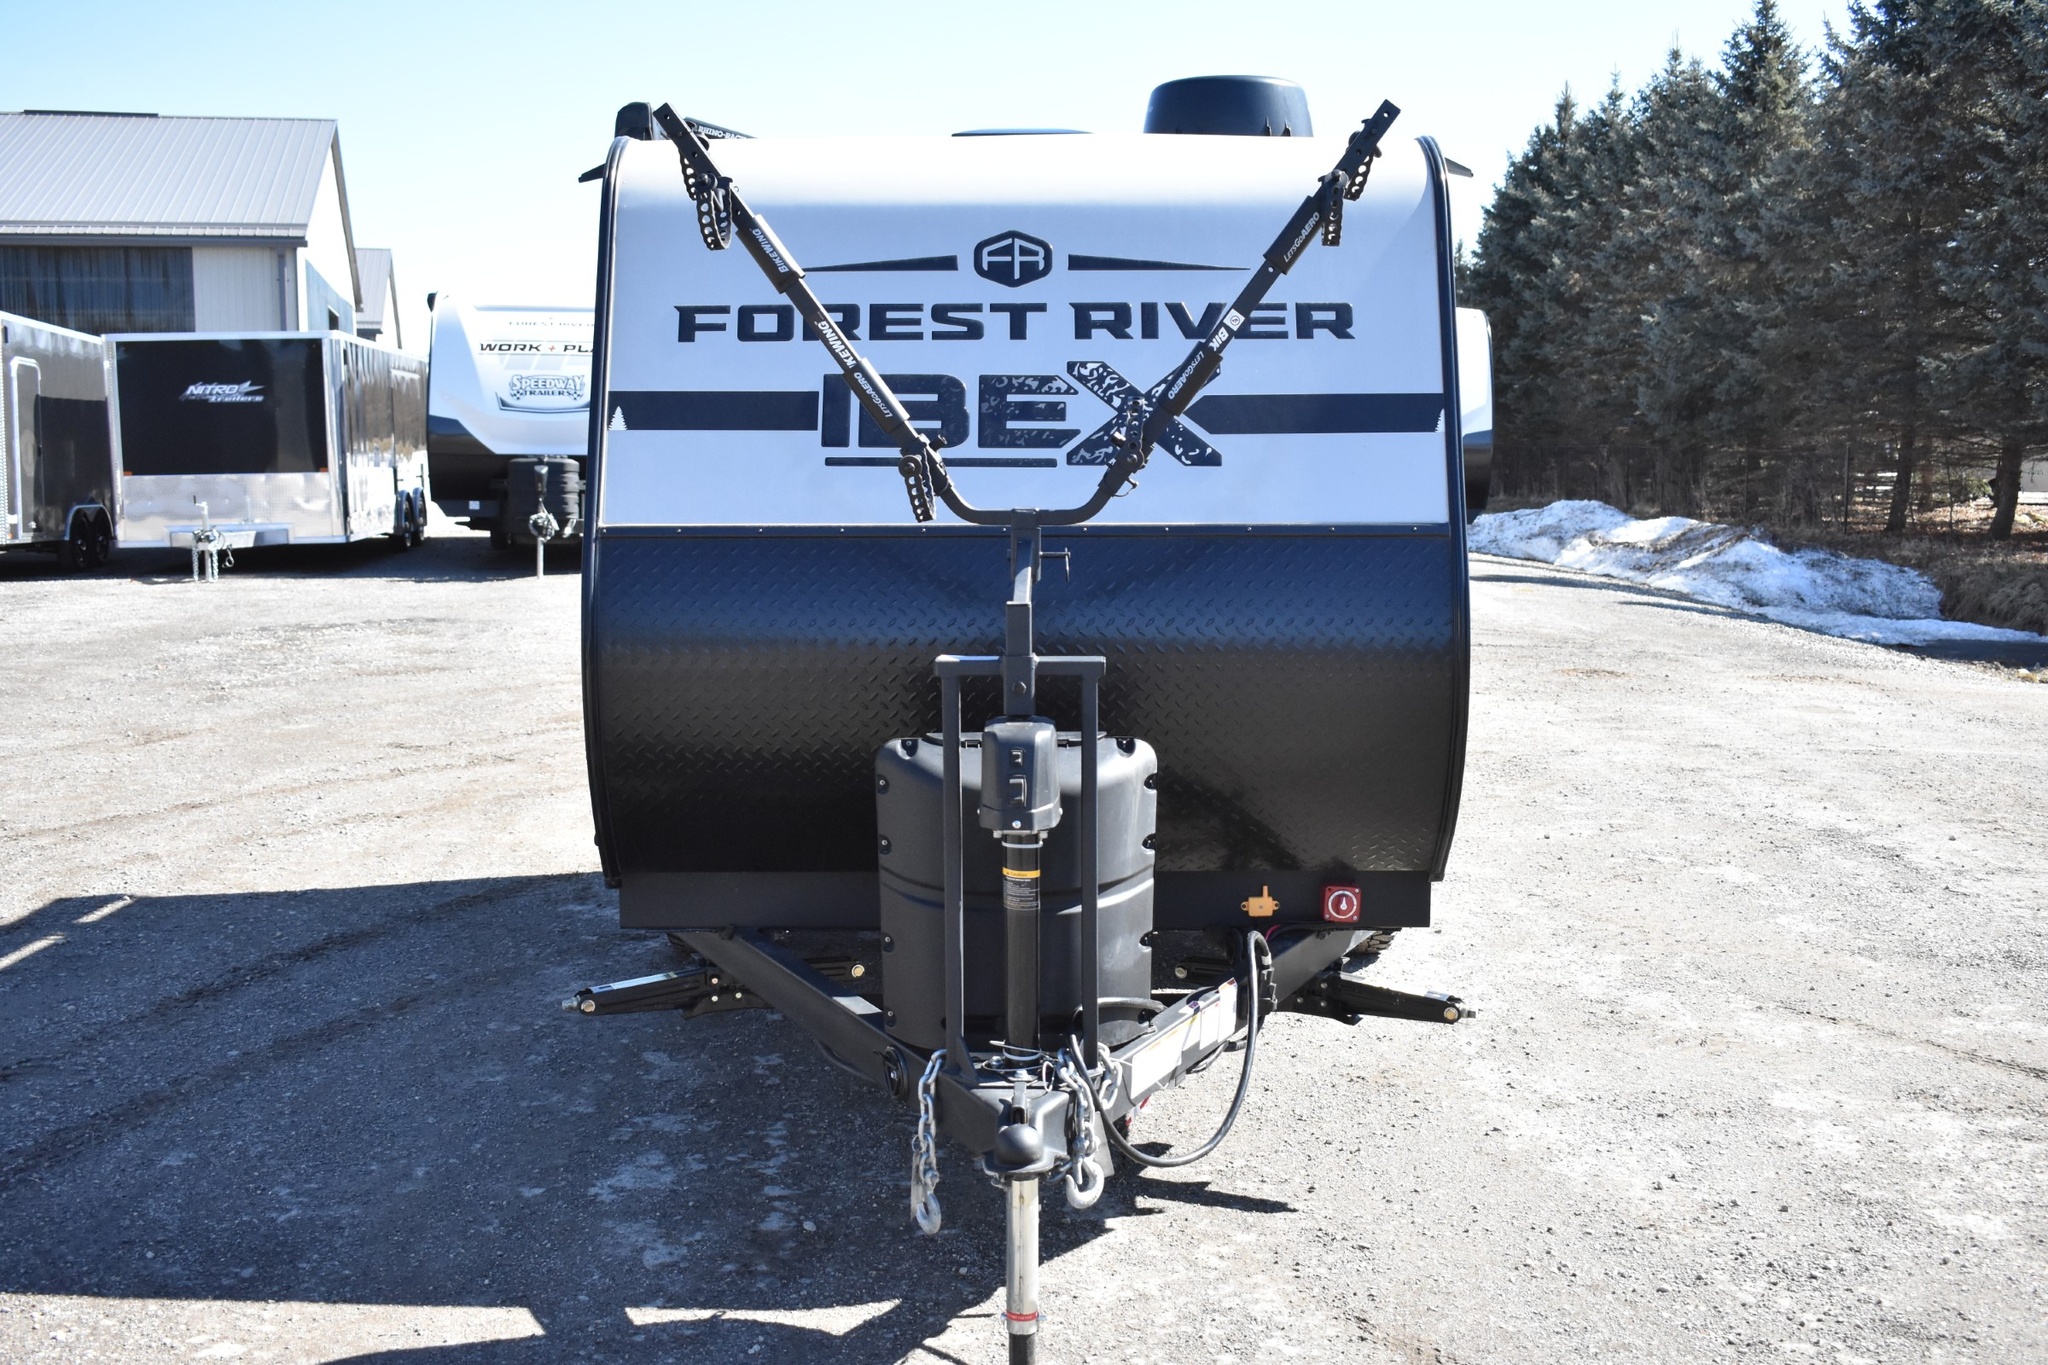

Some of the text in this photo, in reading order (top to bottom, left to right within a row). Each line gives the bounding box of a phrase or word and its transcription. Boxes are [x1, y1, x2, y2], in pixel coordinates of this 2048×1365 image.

[698, 125, 747, 139] RHINO-RAC
[673, 302, 1356, 343] FOREST RIVER
[480, 343, 542, 352] WORK
[816, 319, 858, 369] KEWING
[186, 384, 240, 395] NITRO
[510, 374, 585, 391] SPEEDWAY
[821, 361, 1222, 466] IBEX
